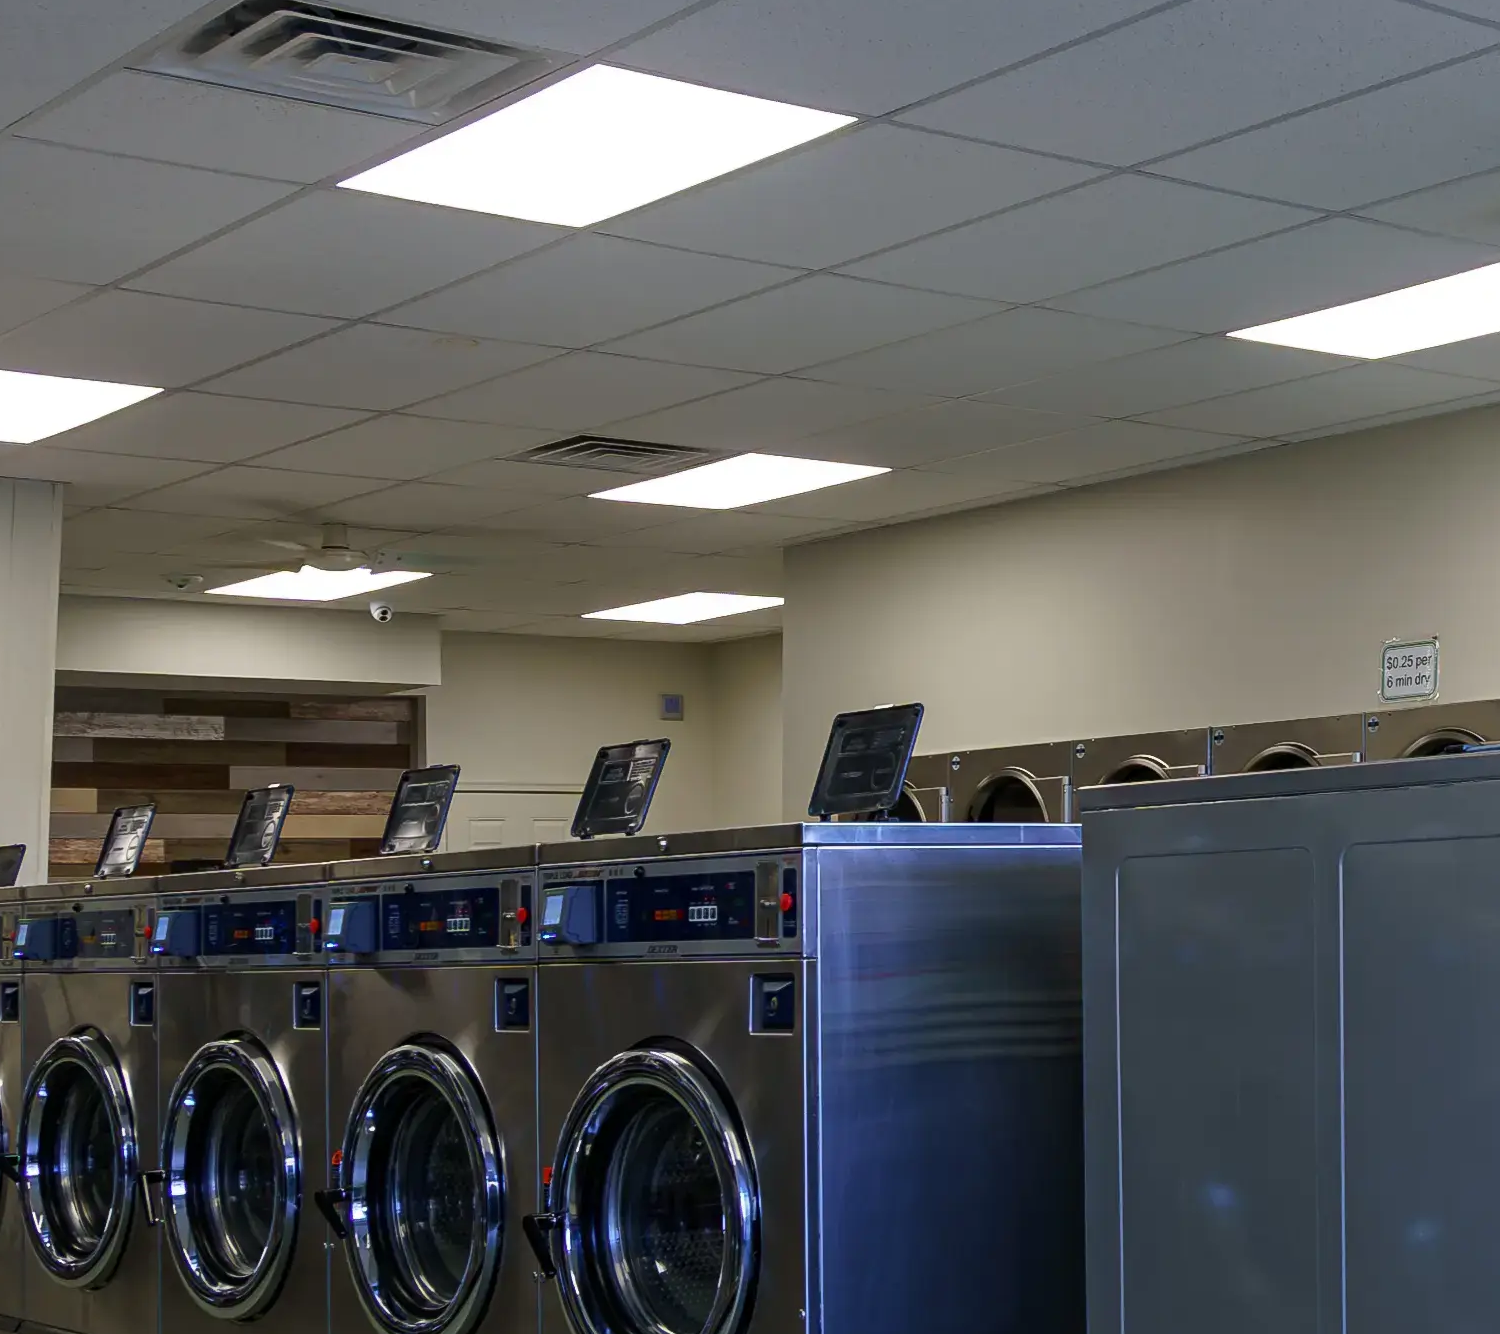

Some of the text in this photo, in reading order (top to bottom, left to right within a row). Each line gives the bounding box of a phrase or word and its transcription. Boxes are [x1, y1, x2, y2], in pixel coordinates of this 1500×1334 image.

[1386, 654, 1433, 670] $0.25 per
[1395, 673, 1413, 687] min
[1414, 672, 1431, 687] dry
